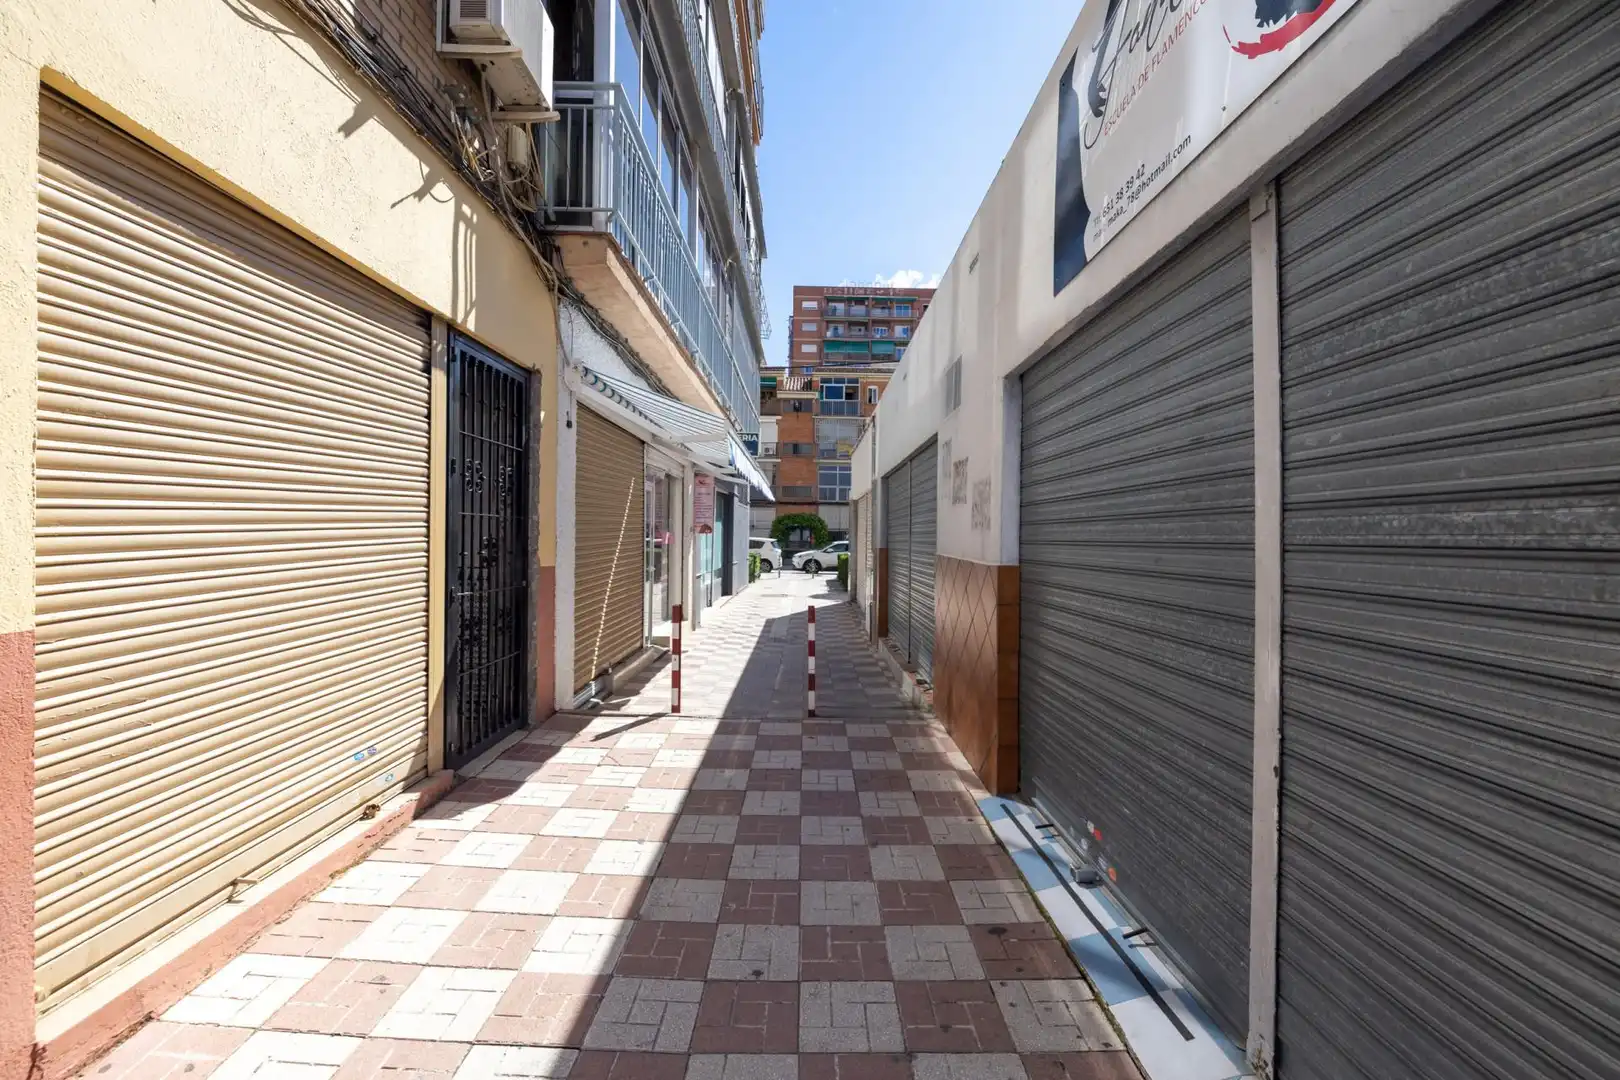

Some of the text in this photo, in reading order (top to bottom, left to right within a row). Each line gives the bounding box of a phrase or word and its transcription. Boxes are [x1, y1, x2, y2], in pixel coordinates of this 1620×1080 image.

[1103, 85, 1136, 136] ESCUELA
[1138, 66, 1151, 90] DE
[1102, 199, 1114, 218] 651
[1125, 176, 1134, 194] 39
[1136, 163, 1145, 180] 42
